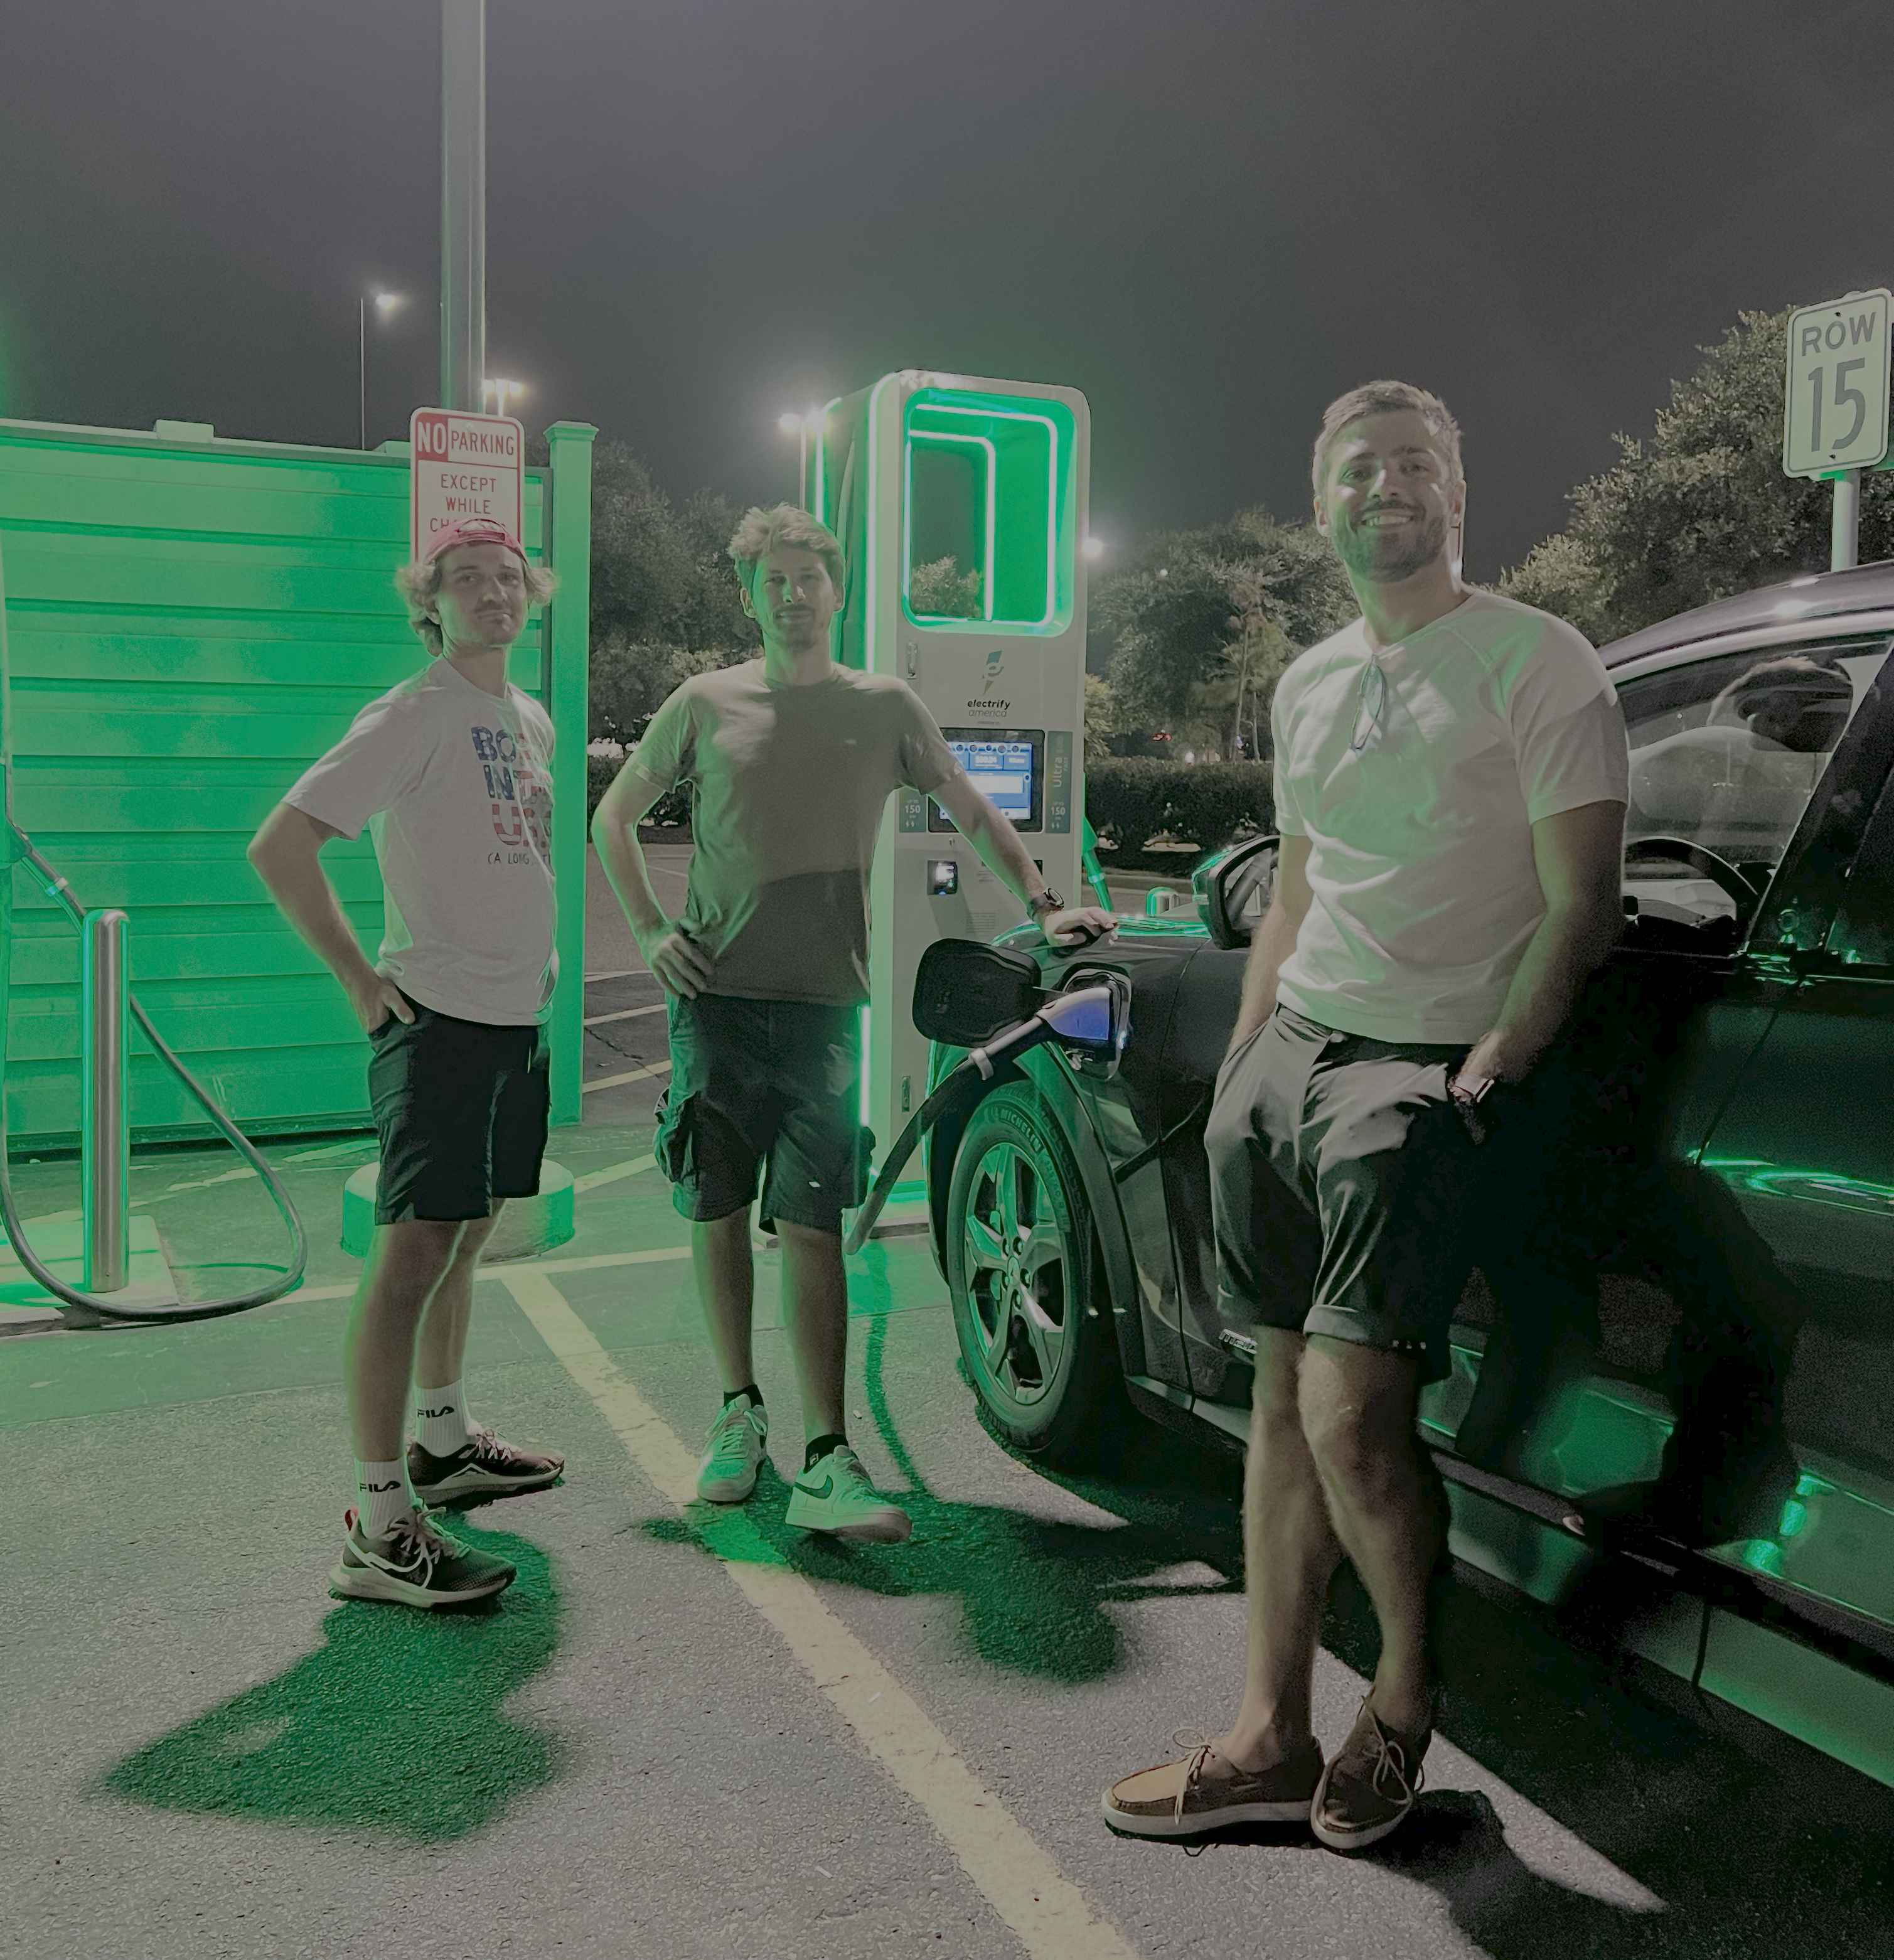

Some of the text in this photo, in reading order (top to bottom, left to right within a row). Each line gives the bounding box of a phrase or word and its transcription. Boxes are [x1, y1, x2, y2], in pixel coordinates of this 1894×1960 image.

[1801, 311, 1876, 356] ROW
[1807, 356, 1866, 453] 15
[417, 421, 515, 456] NO PARKING
[441, 473, 496, 493] EXCEPT
[446, 496, 491, 515] WHILE
[967, 699, 1010, 710] electrify
[968, 709, 1008, 717] america
[1052, 757, 1063, 788] Ultra
[904, 805, 921, 814] 150
[1051, 806, 1066, 816] 150
[1000, 1108, 1043, 1152] MICHELIN
[417, 1405, 455, 1418] FILA
[359, 1479, 402, 1493] FILA
